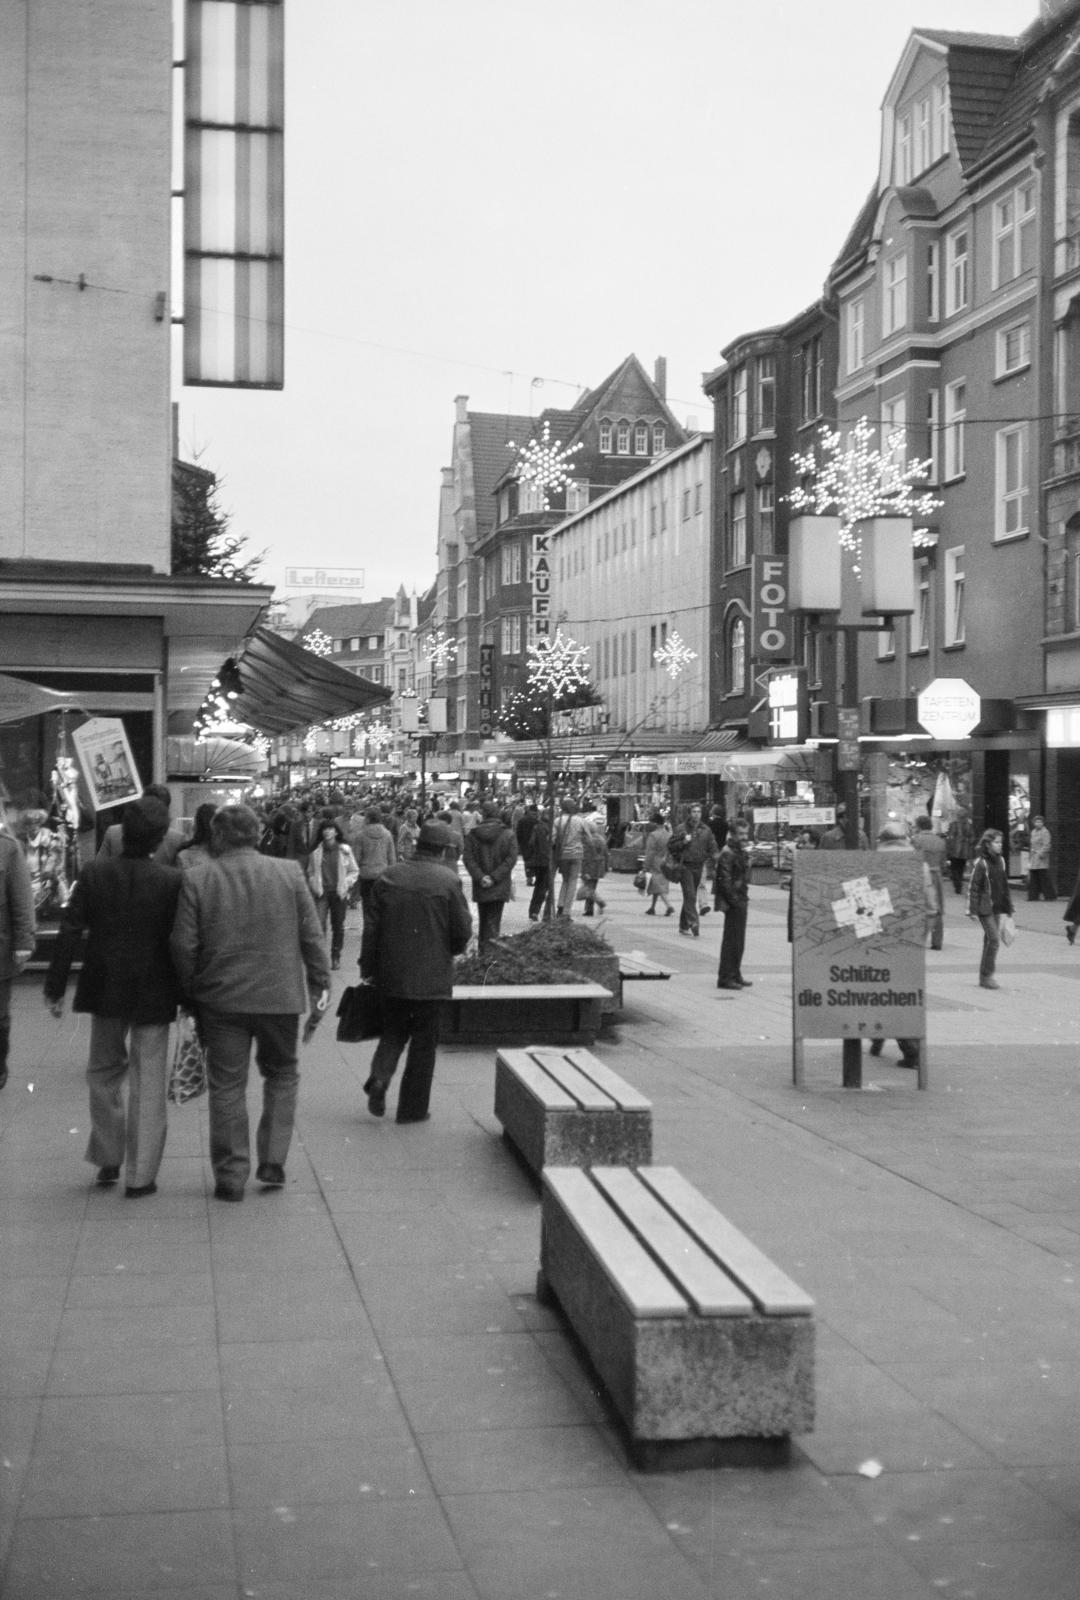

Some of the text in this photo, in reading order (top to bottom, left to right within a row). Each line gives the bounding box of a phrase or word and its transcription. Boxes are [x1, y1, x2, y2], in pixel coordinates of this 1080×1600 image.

[535, 536, 550, 653] KAUFHA
[760, 561, 786, 651] FOTO
[481, 648, 492, 735] TCHIBO
[923, 696, 975, 707] TAPETEN
[921, 711, 976, 721] ZENTRUM
[829, 965, 891, 983] Schütze
[798, 988, 924, 1007] die Schwachen!
